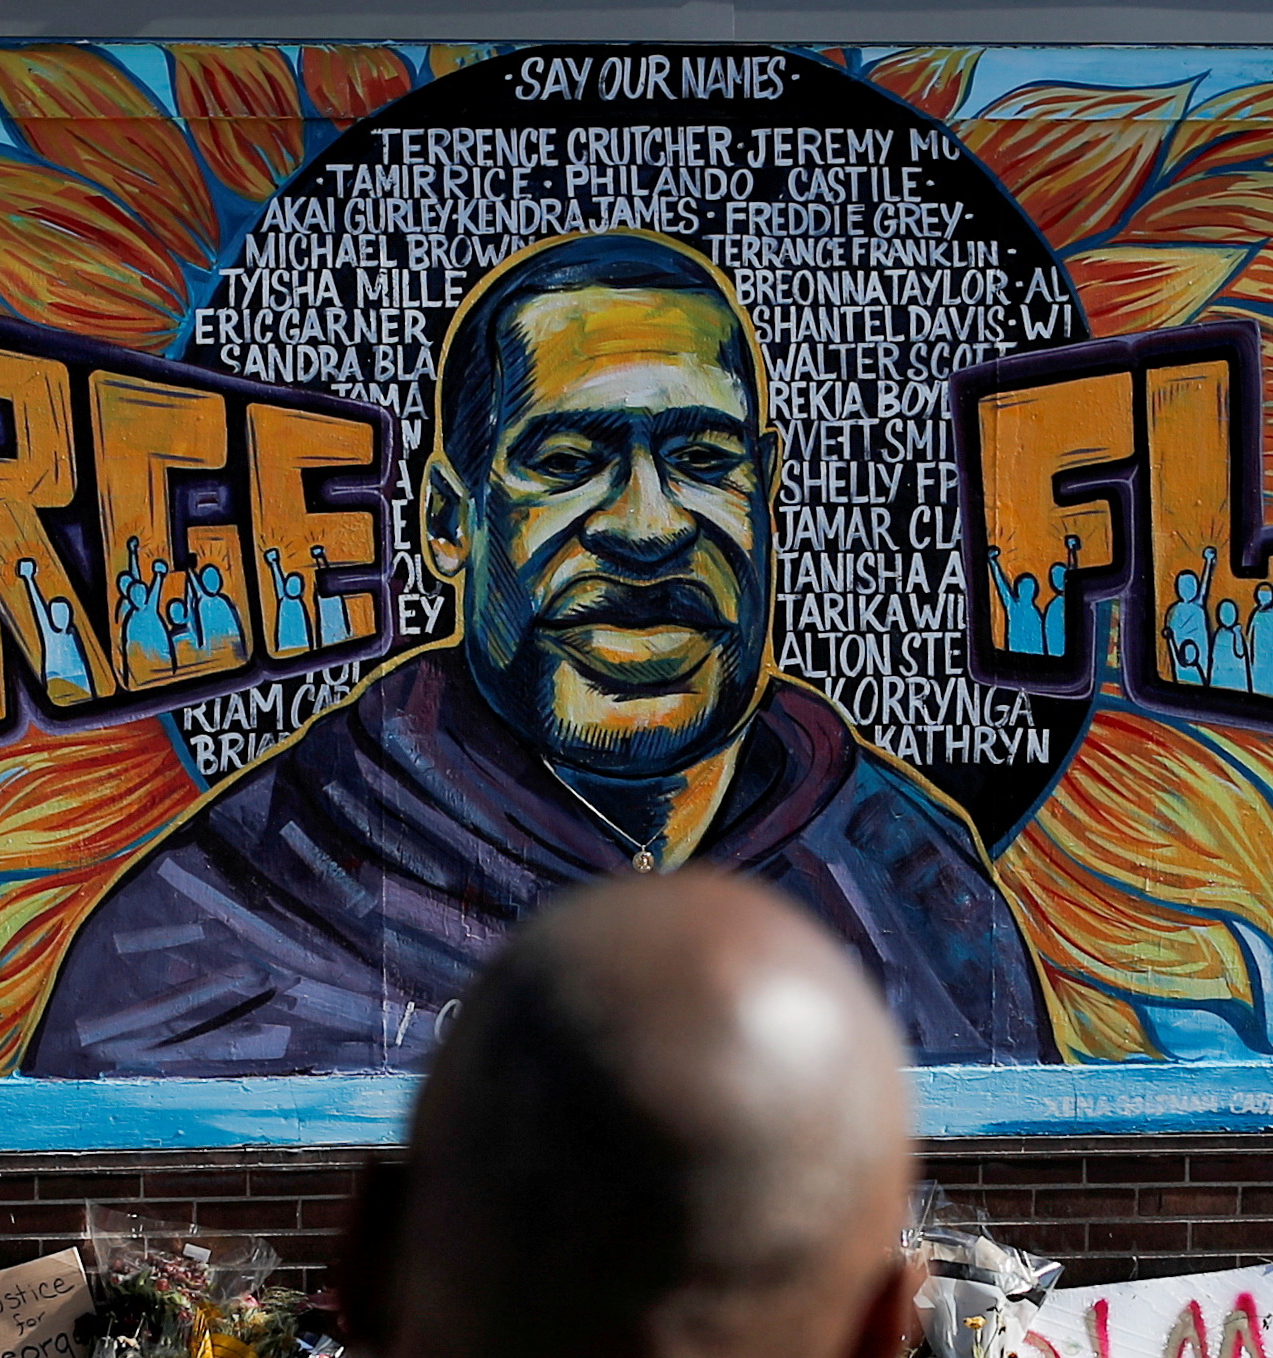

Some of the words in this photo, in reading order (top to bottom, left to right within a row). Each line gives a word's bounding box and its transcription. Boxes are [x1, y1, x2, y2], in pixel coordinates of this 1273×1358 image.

[515, 57, 593, 100] SAY
[598, 55, 678, 100] OUR
[682, 57, 785, 99] NAMES
[371, 128, 558, 166] TERRENCE
[567, 126, 734, 167] CRUTCHER
[747, 128, 894, 168] JEREMY
[327, 164, 440, 199] TAMIR
[443, 165, 532, 199] RICE
[566, 165, 754, 199] PHILANDO
[788, 166, 923, 203] CASTILE
[260, 197, 335, 233] AKAI
[589, 197, 698, 236] JAMES
[726, 201, 865, 237] FREDDIE
[873, 201, 964, 240] GREY
[245, 233, 398, 270] MICHAEL
[702, 234, 848, 269] TERRANCE
[851, 237, 999, 268] FRANKLIN
[218, 268, 341, 312] TYISHA
[195, 308, 273, 345] ERIC
[278, 308, 432, 347] GARNER
[752, 305, 905, 343] SHANTEL
[908, 306, 1006, 343] DAVIS
[220, 345, 365, 383] SANDRA
[761, 343, 904, 382] WALTER
[769, 380, 870, 420] REKIA
[779, 460, 904, 504] SHELLY
[773, 506, 900, 553] JAMAR
[777, 551, 929, 594] TANISHA
[777, 593, 910, 633] TARIKA
[778, 632, 892, 678] ALTON
[898, 631, 964, 676] STE
[873, 724, 1051, 766] KATHRYN
[12, 1310, 46, 1337] for
